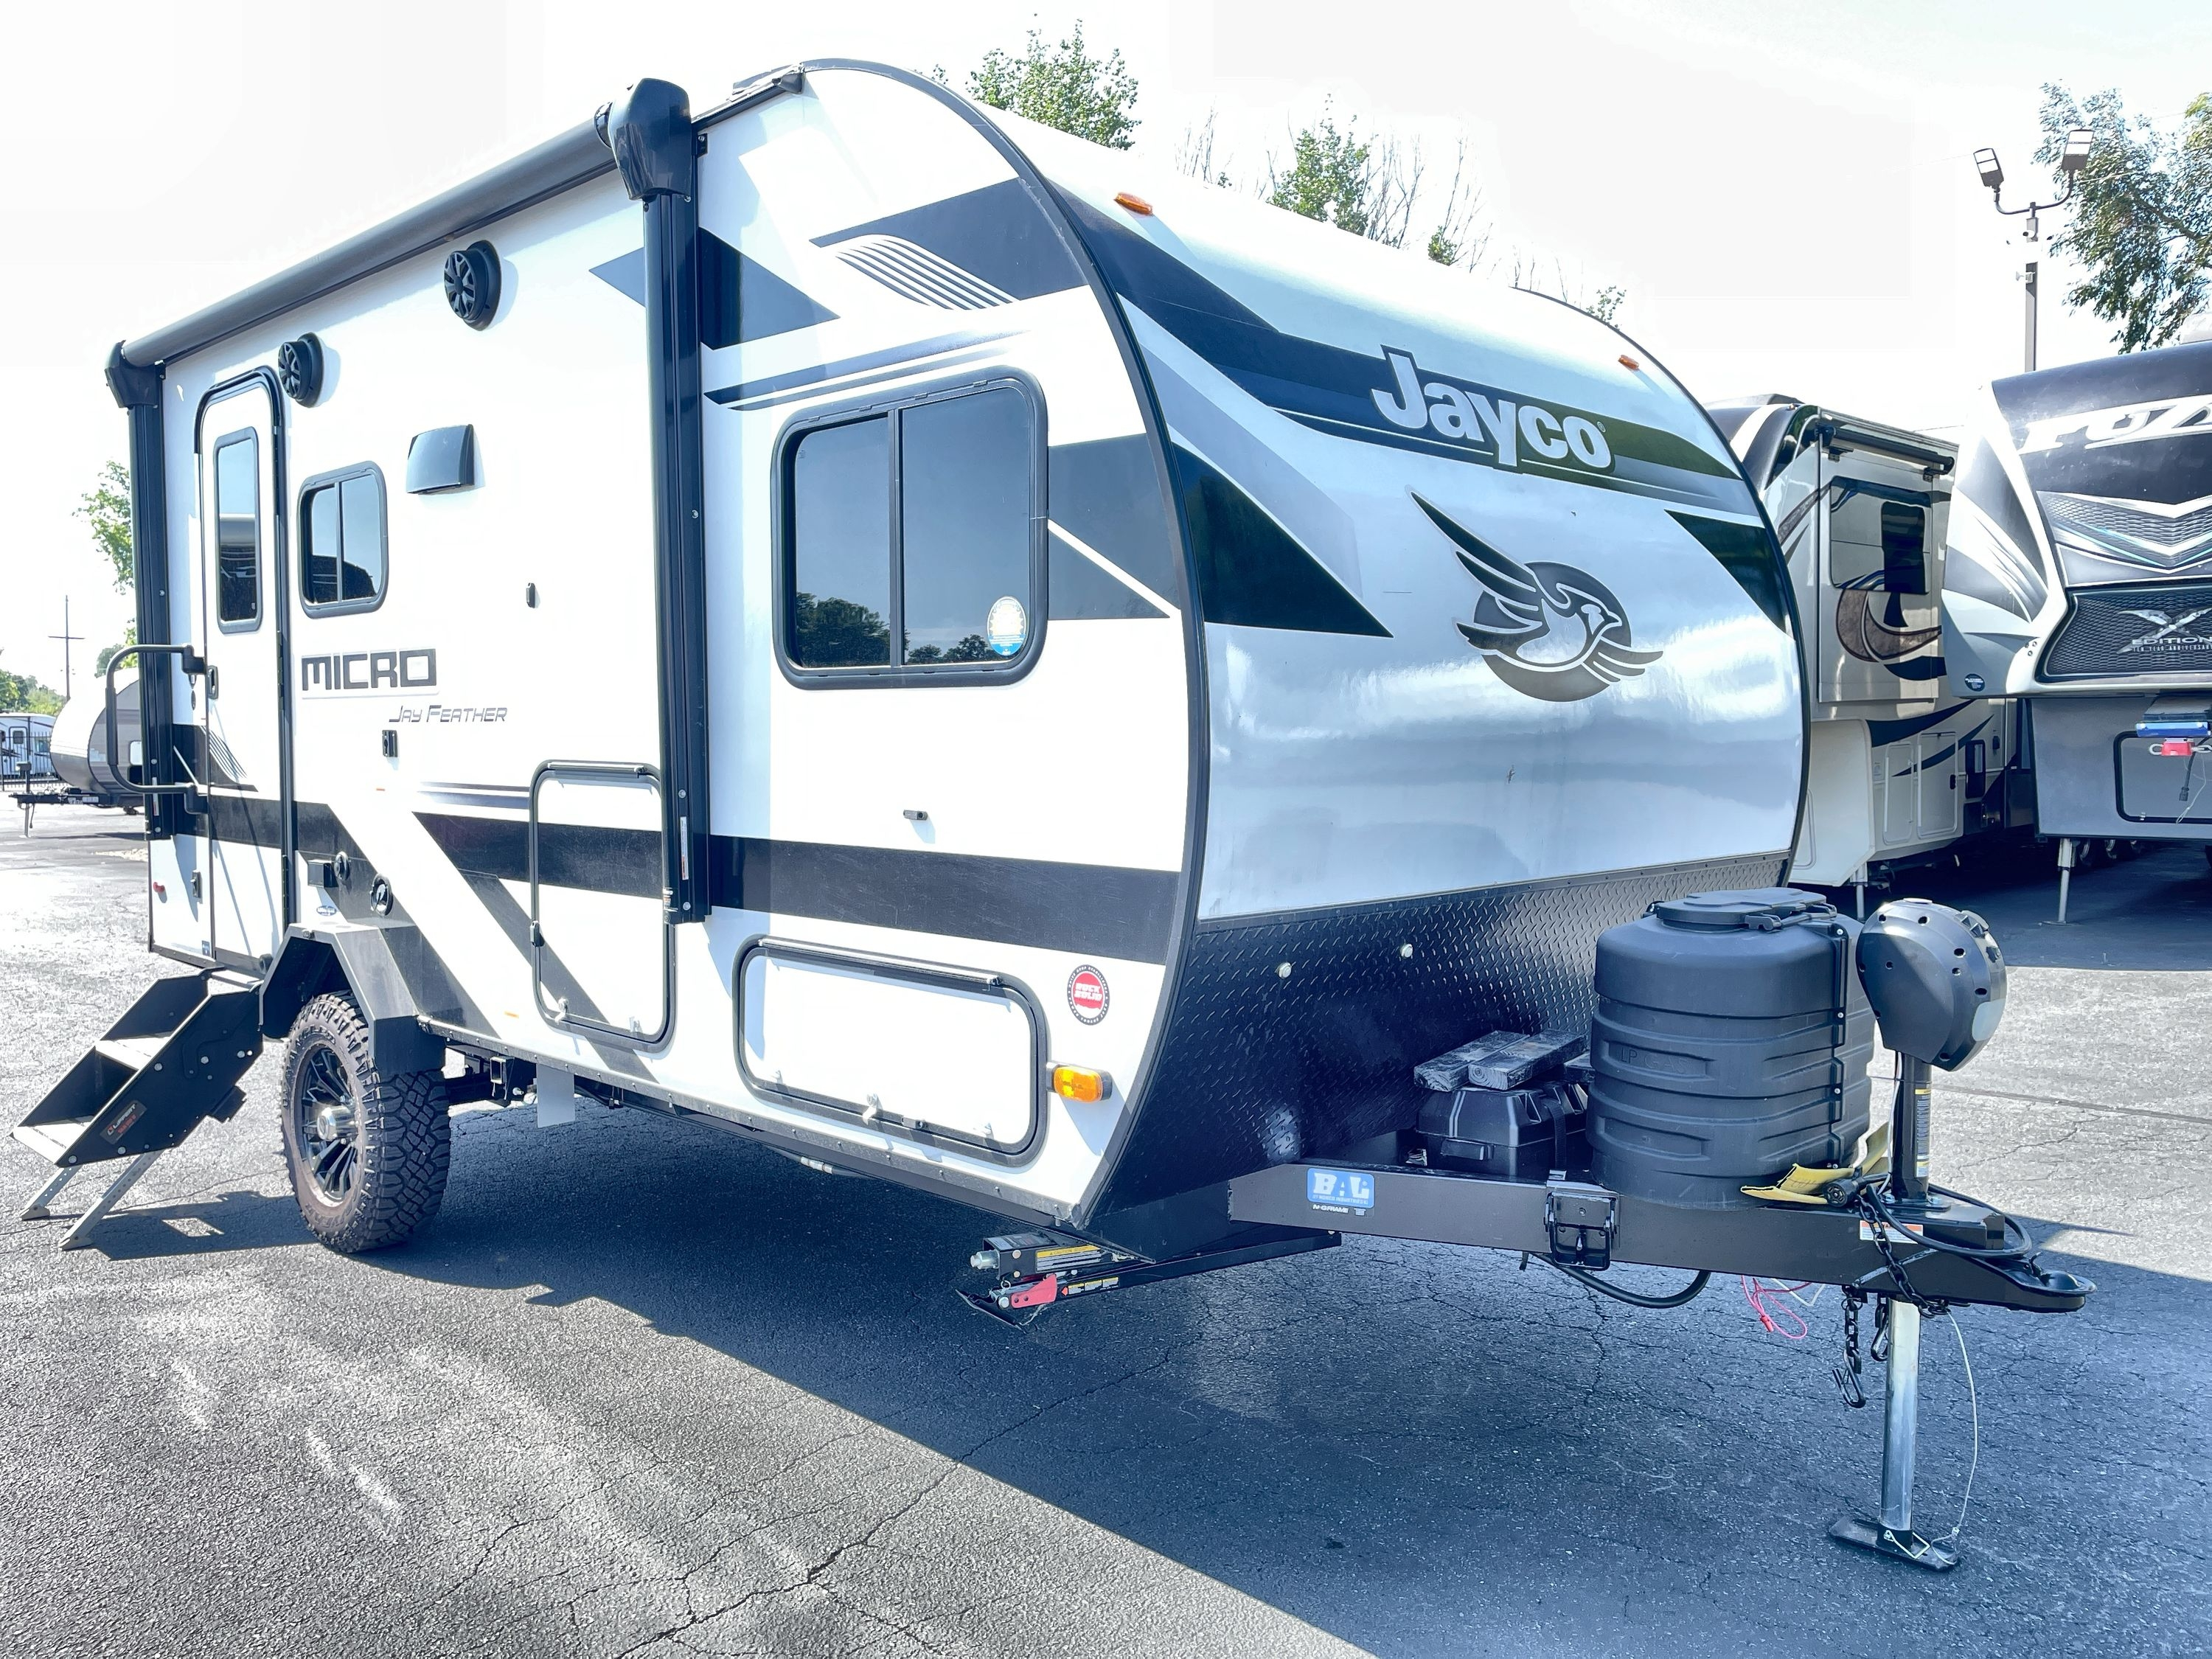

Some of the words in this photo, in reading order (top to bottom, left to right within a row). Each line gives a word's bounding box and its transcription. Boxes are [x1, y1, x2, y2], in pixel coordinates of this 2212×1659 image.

[1371, 351, 1612, 468] Jayco
[2132, 636, 2212, 645] EDITION
[301, 648, 437, 691] MICRO
[1621, 1047, 1638, 1064] LP
